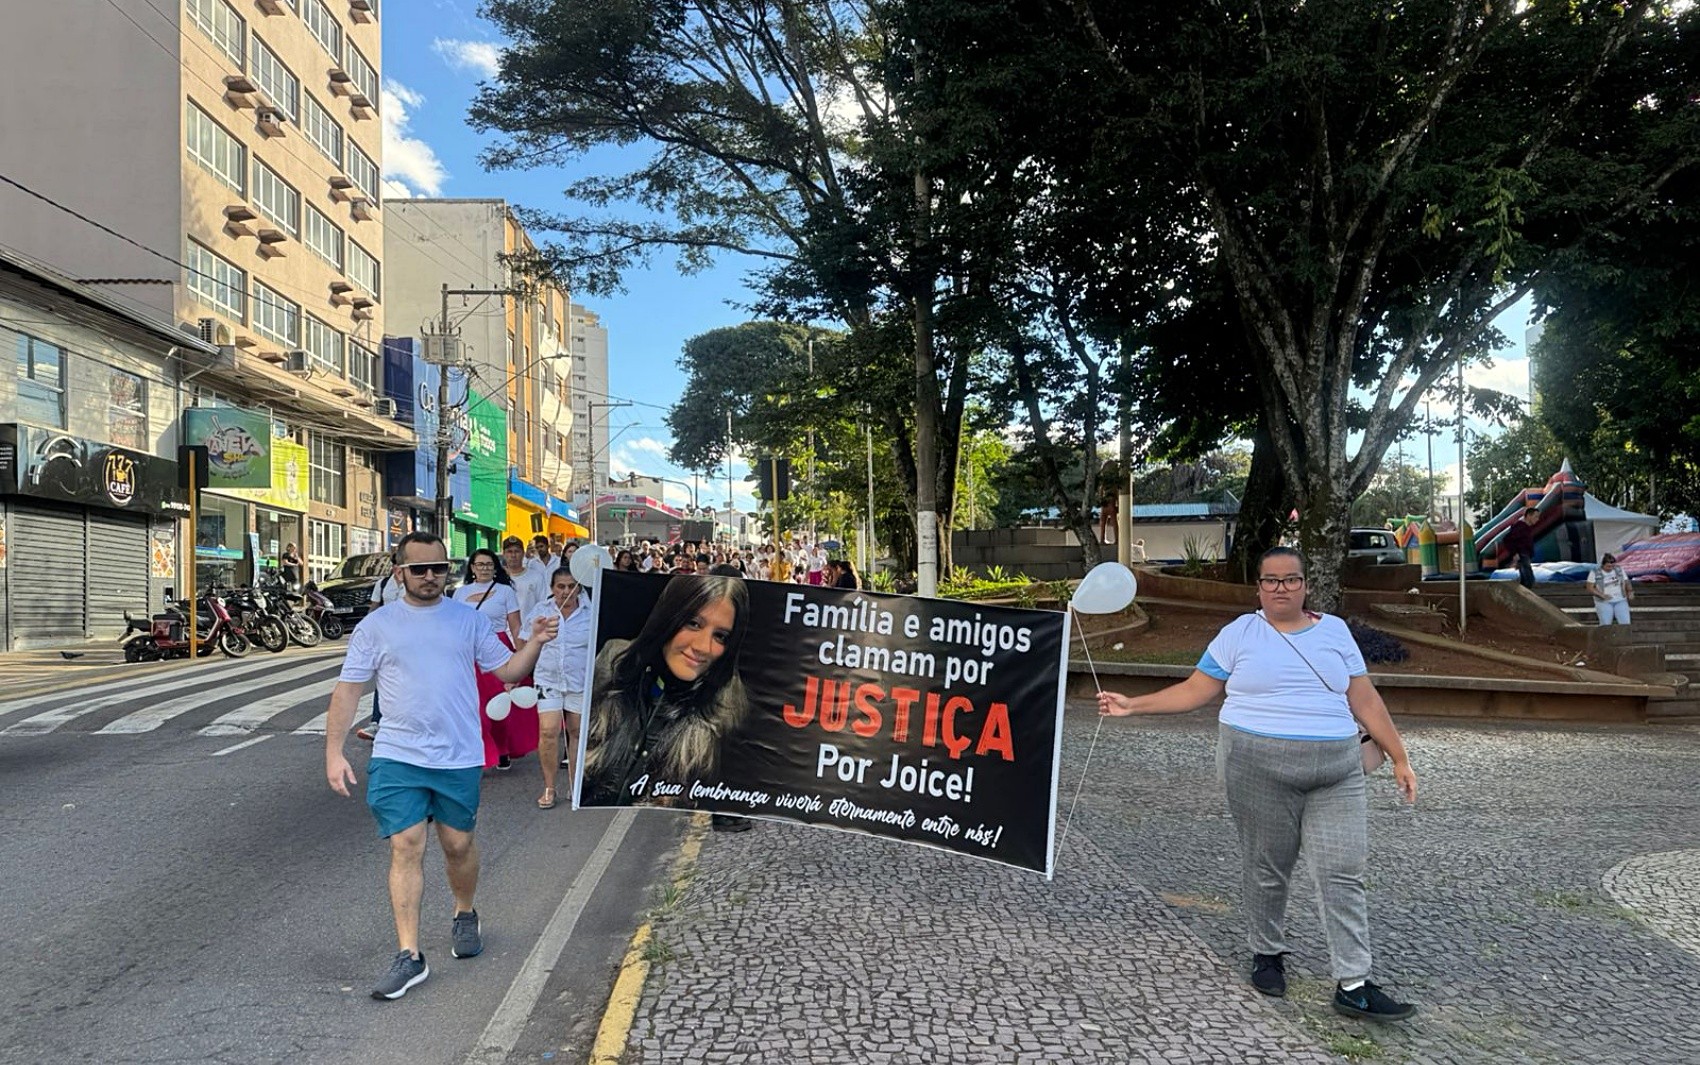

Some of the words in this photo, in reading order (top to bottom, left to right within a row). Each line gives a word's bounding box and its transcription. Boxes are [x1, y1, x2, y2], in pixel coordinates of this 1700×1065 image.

[783, 592, 894, 636] Família
[903, 613, 920, 638] e
[929, 613, 1032, 657] amigos
[818, 634, 936, 678] clamam
[944, 655, 995, 690] por
[782, 675, 1015, 762] JUSTIÇA
[816, 743, 873, 784] Por
[879, 753, 974, 803] Joice!
[629, 774, 650, 796] A
[651, 781, 684, 797] sua
[688, 779, 771, 808] lembrança
[775, 793, 824, 813] viverá
[828, 797, 917, 830] eternamente
[921, 815, 961, 839] entre
[964, 822, 1003, 849] nós!
